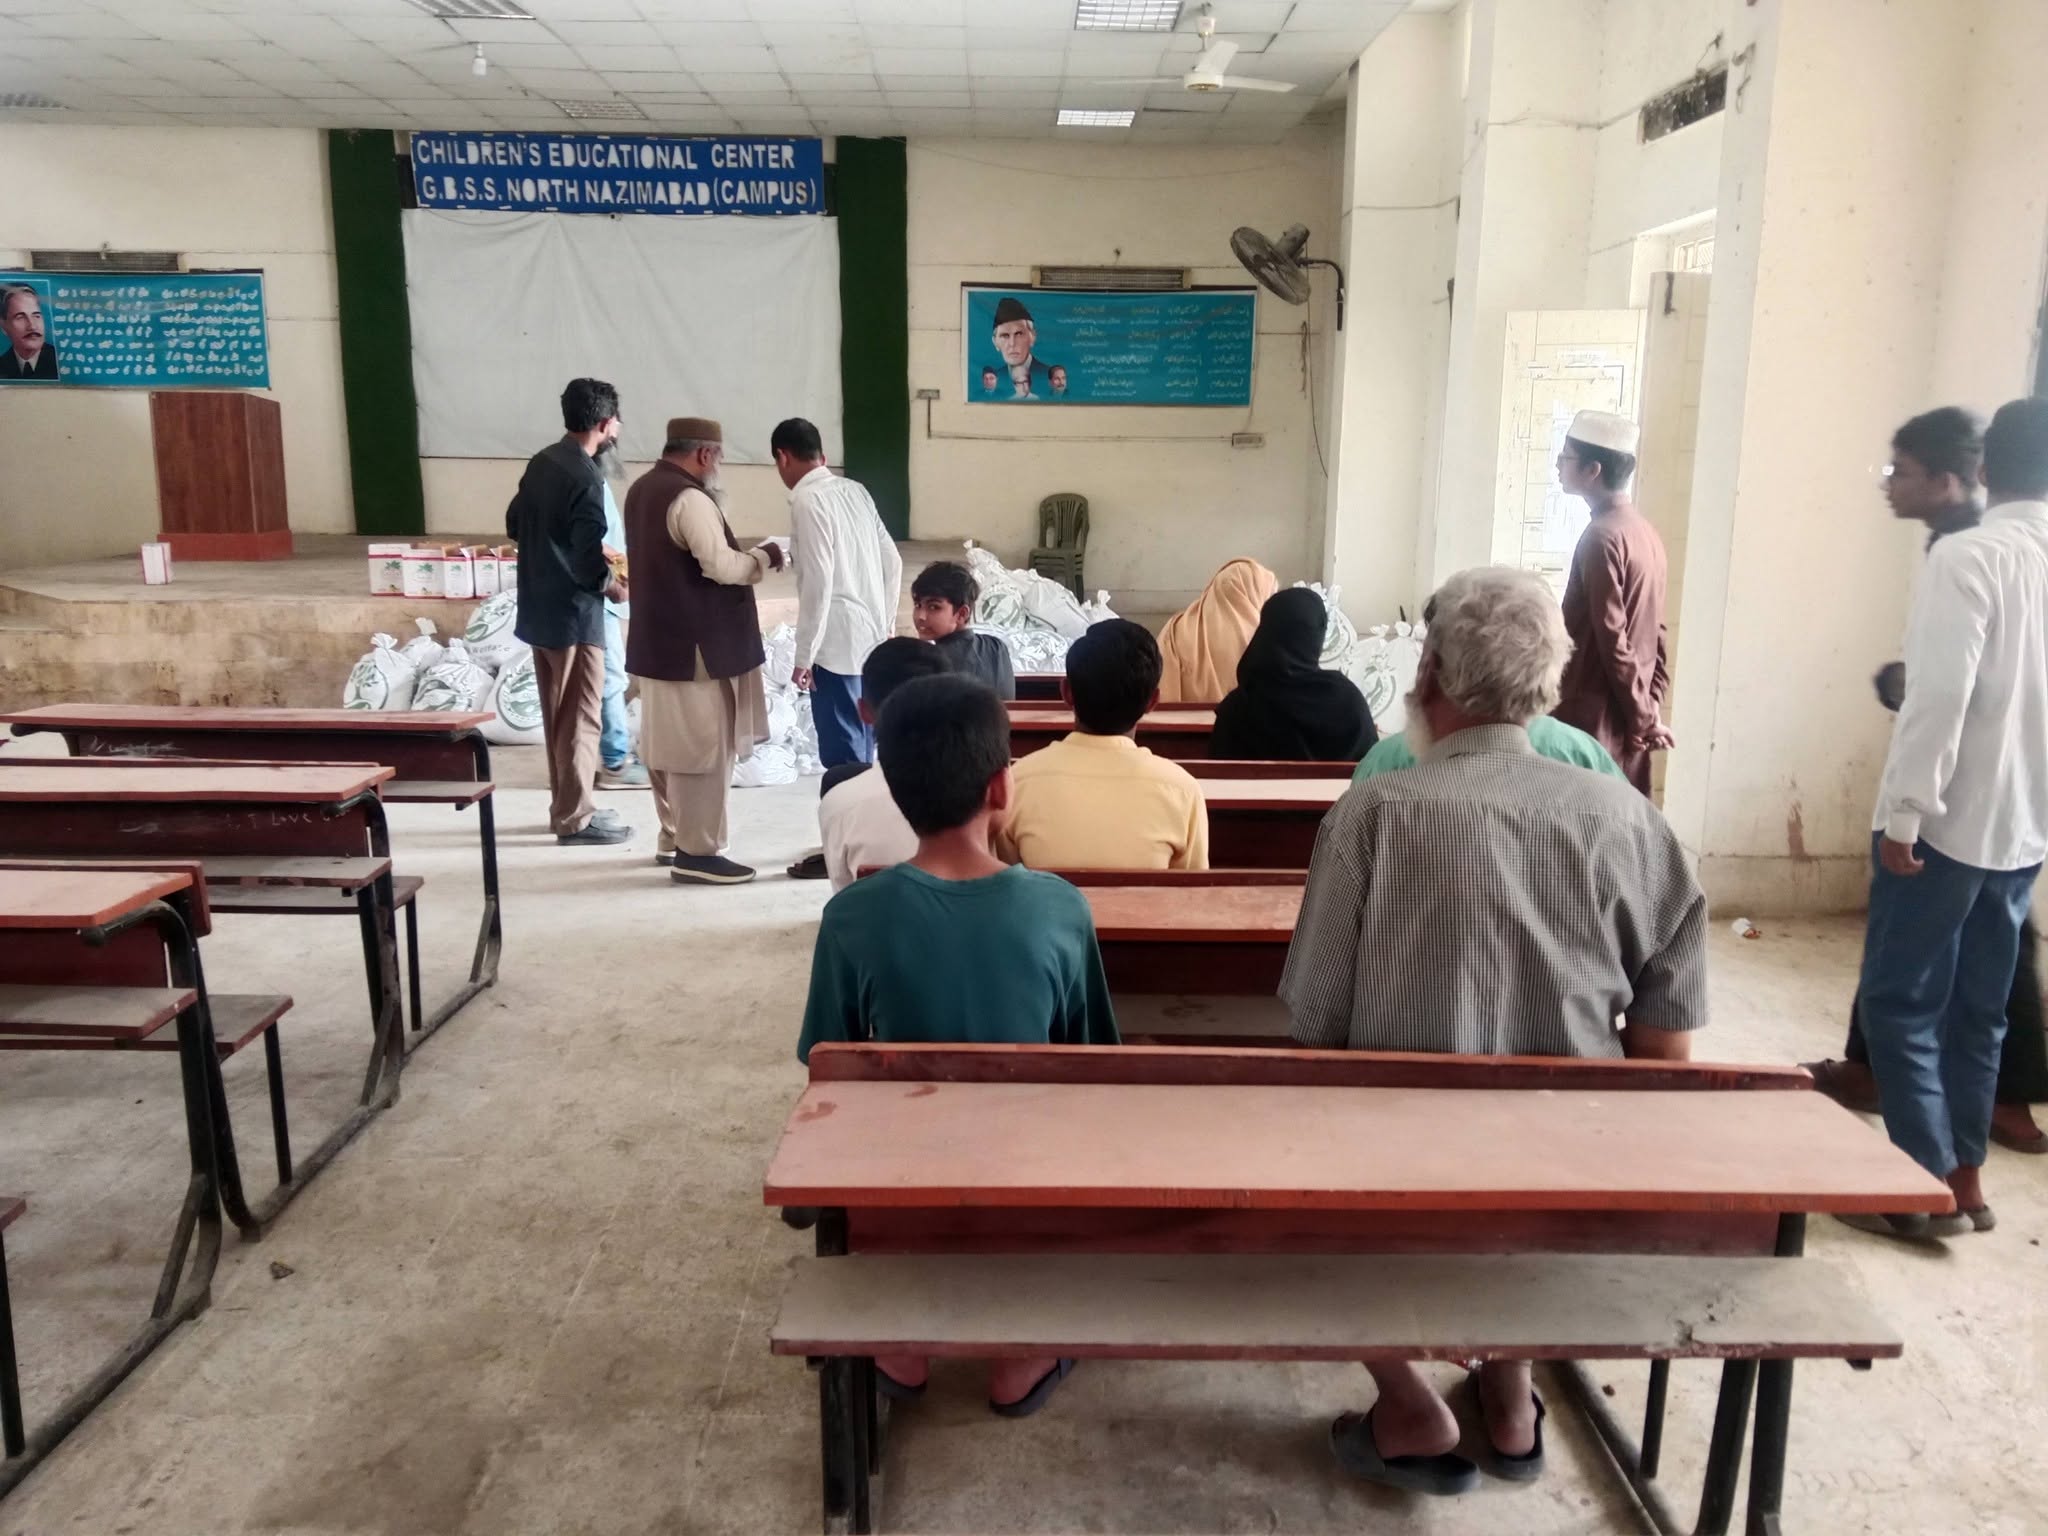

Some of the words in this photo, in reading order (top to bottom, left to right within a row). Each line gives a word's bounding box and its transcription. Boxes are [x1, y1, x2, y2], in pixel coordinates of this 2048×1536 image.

[417, 139, 542, 167] CHILDREN'S
[548, 142, 698, 169] EDUCATIONAL
[711, 143, 796, 168] CENTER
[422, 175, 503, 201] G.B.S.S.
[506, 177, 580, 203] NORTH
[585, 179, 711, 206] NAZIMABAD
[713, 177, 816, 206] (CAMPUS)
